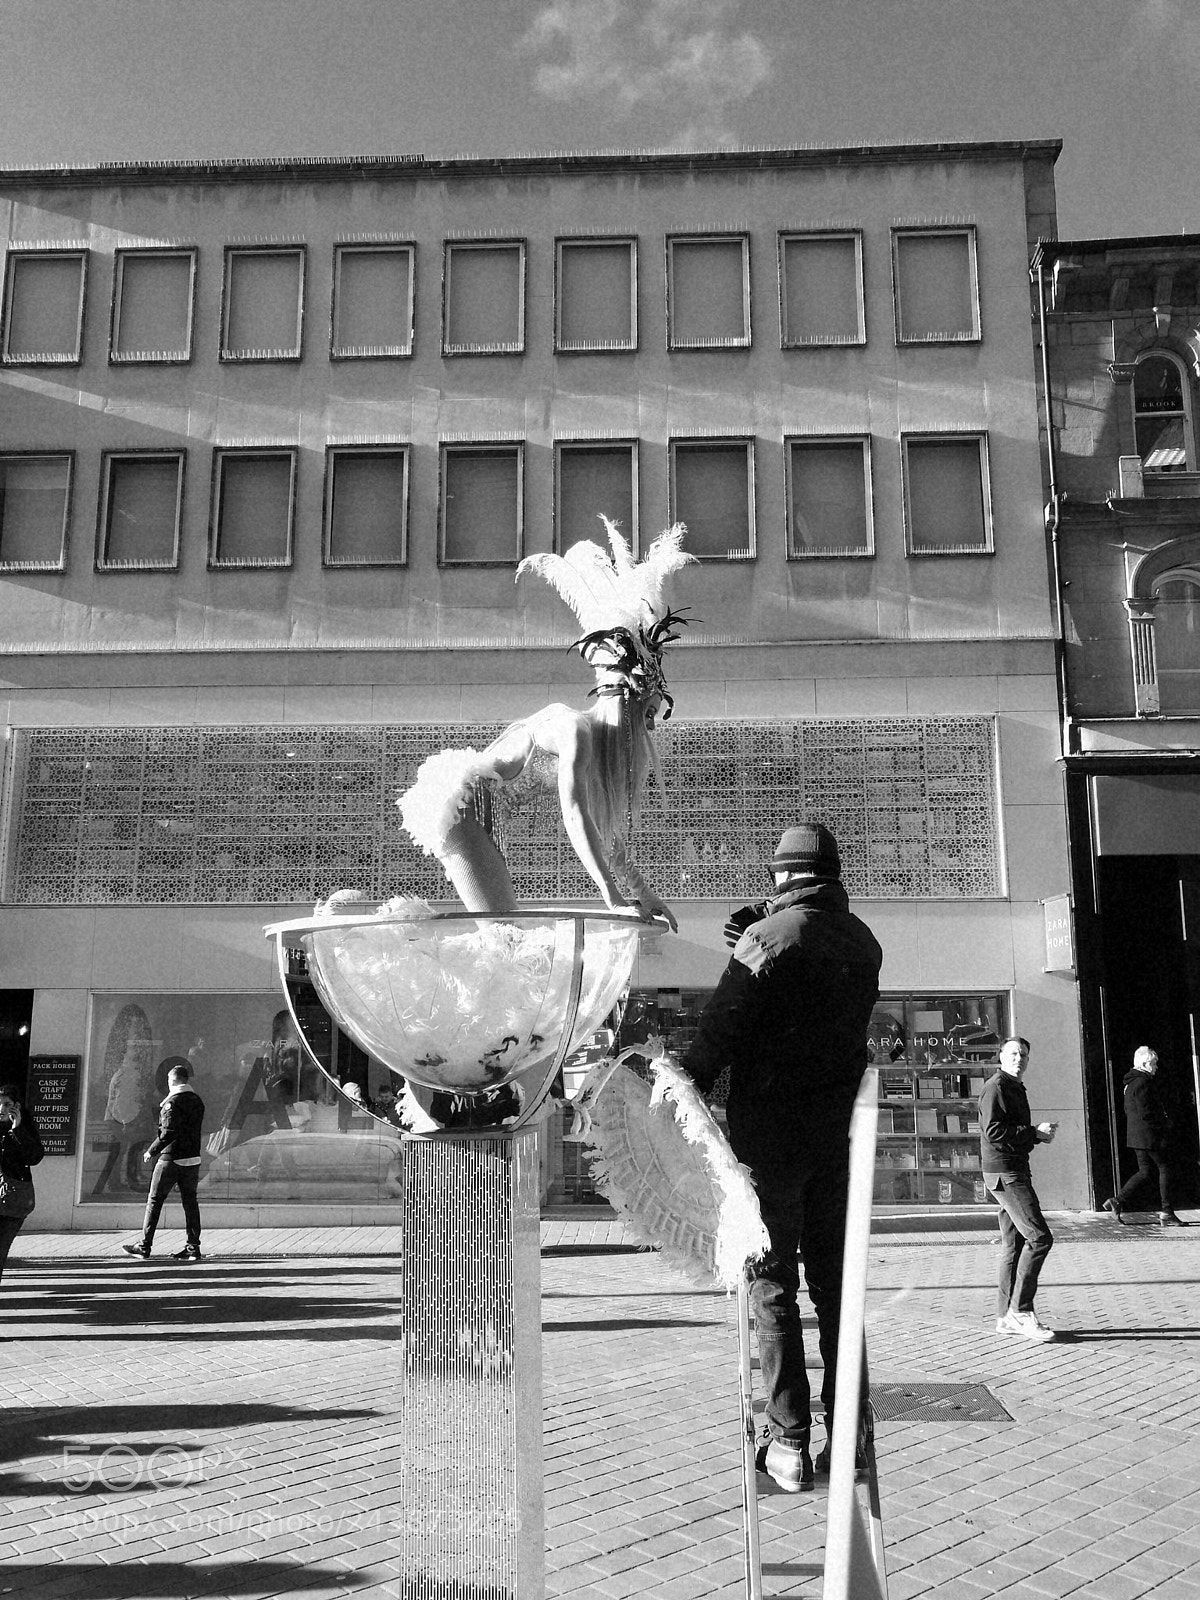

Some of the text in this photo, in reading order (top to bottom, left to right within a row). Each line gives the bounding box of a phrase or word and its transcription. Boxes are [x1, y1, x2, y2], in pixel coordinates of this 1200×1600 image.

[1047, 918, 1068, 932] ZARA
[1047, 935, 1070, 949] HOME
[866, 1037, 969, 1047] ARA HOME
